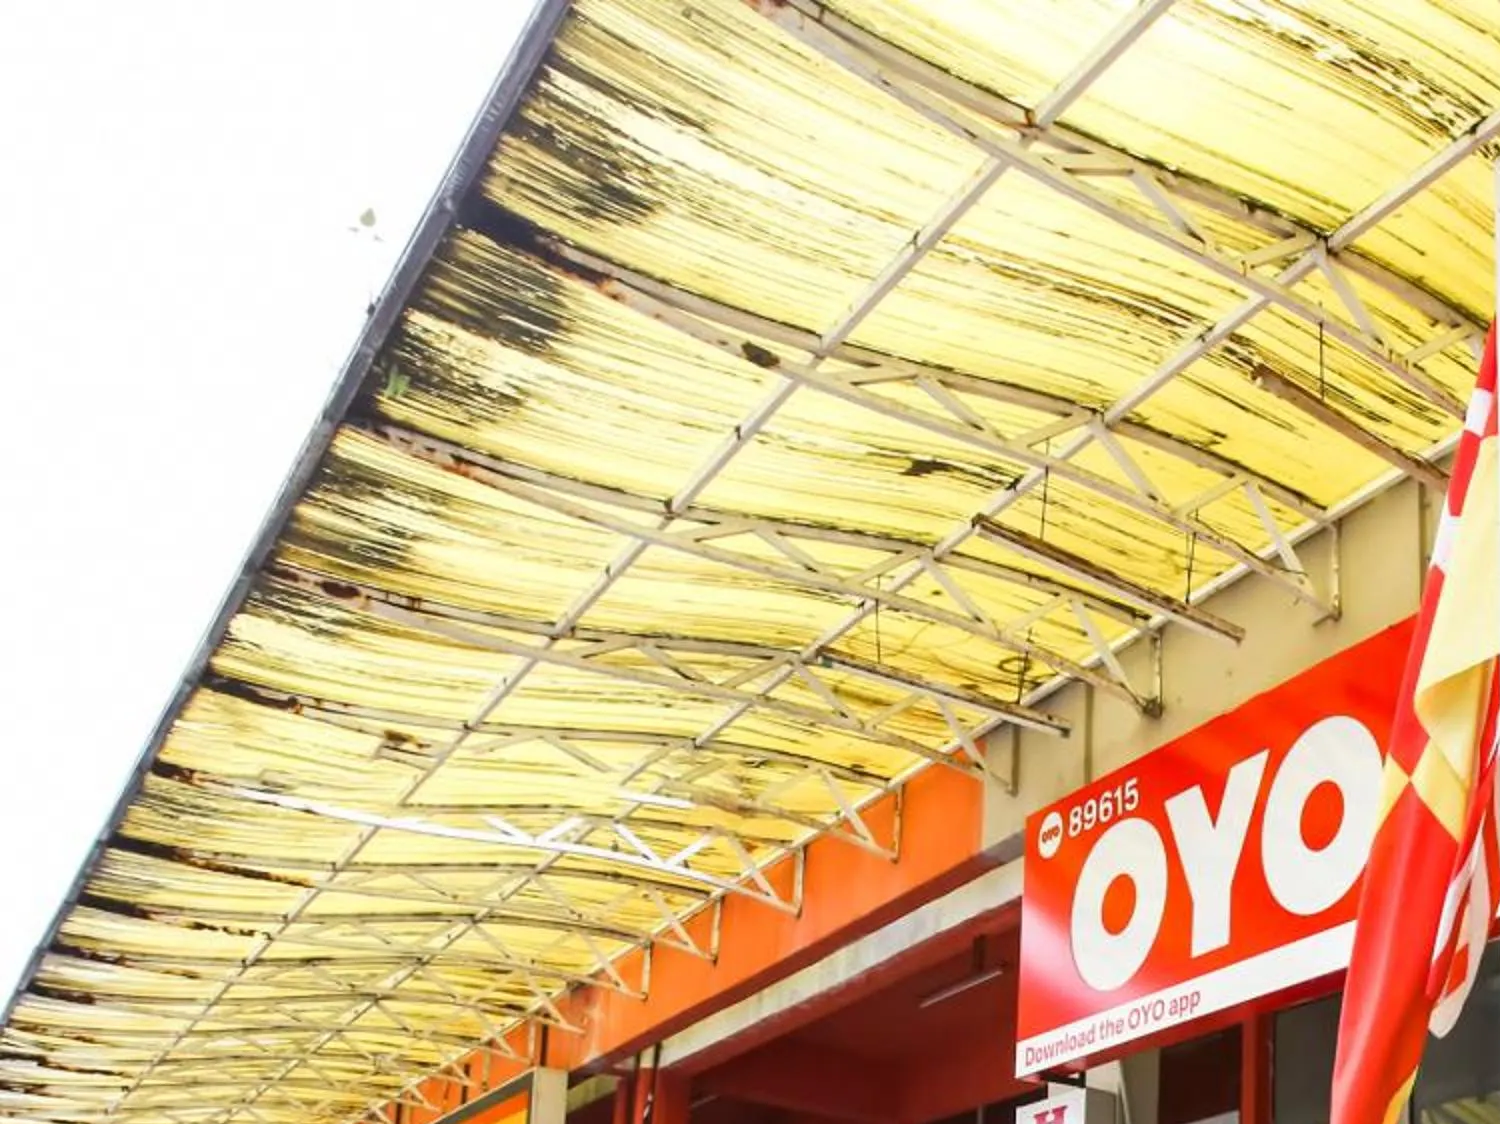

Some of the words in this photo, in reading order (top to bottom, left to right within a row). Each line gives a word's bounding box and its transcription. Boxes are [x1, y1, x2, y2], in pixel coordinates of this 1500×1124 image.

[1068, 777, 1139, 837] 89615
[1071, 716, 1384, 991] OYO
[1025, 1023, 1096, 1067] Download
[1099, 1017, 1125, 1041] the
[1127, 999, 1165, 1029] OYO
[1168, 990, 1201, 1018] app
